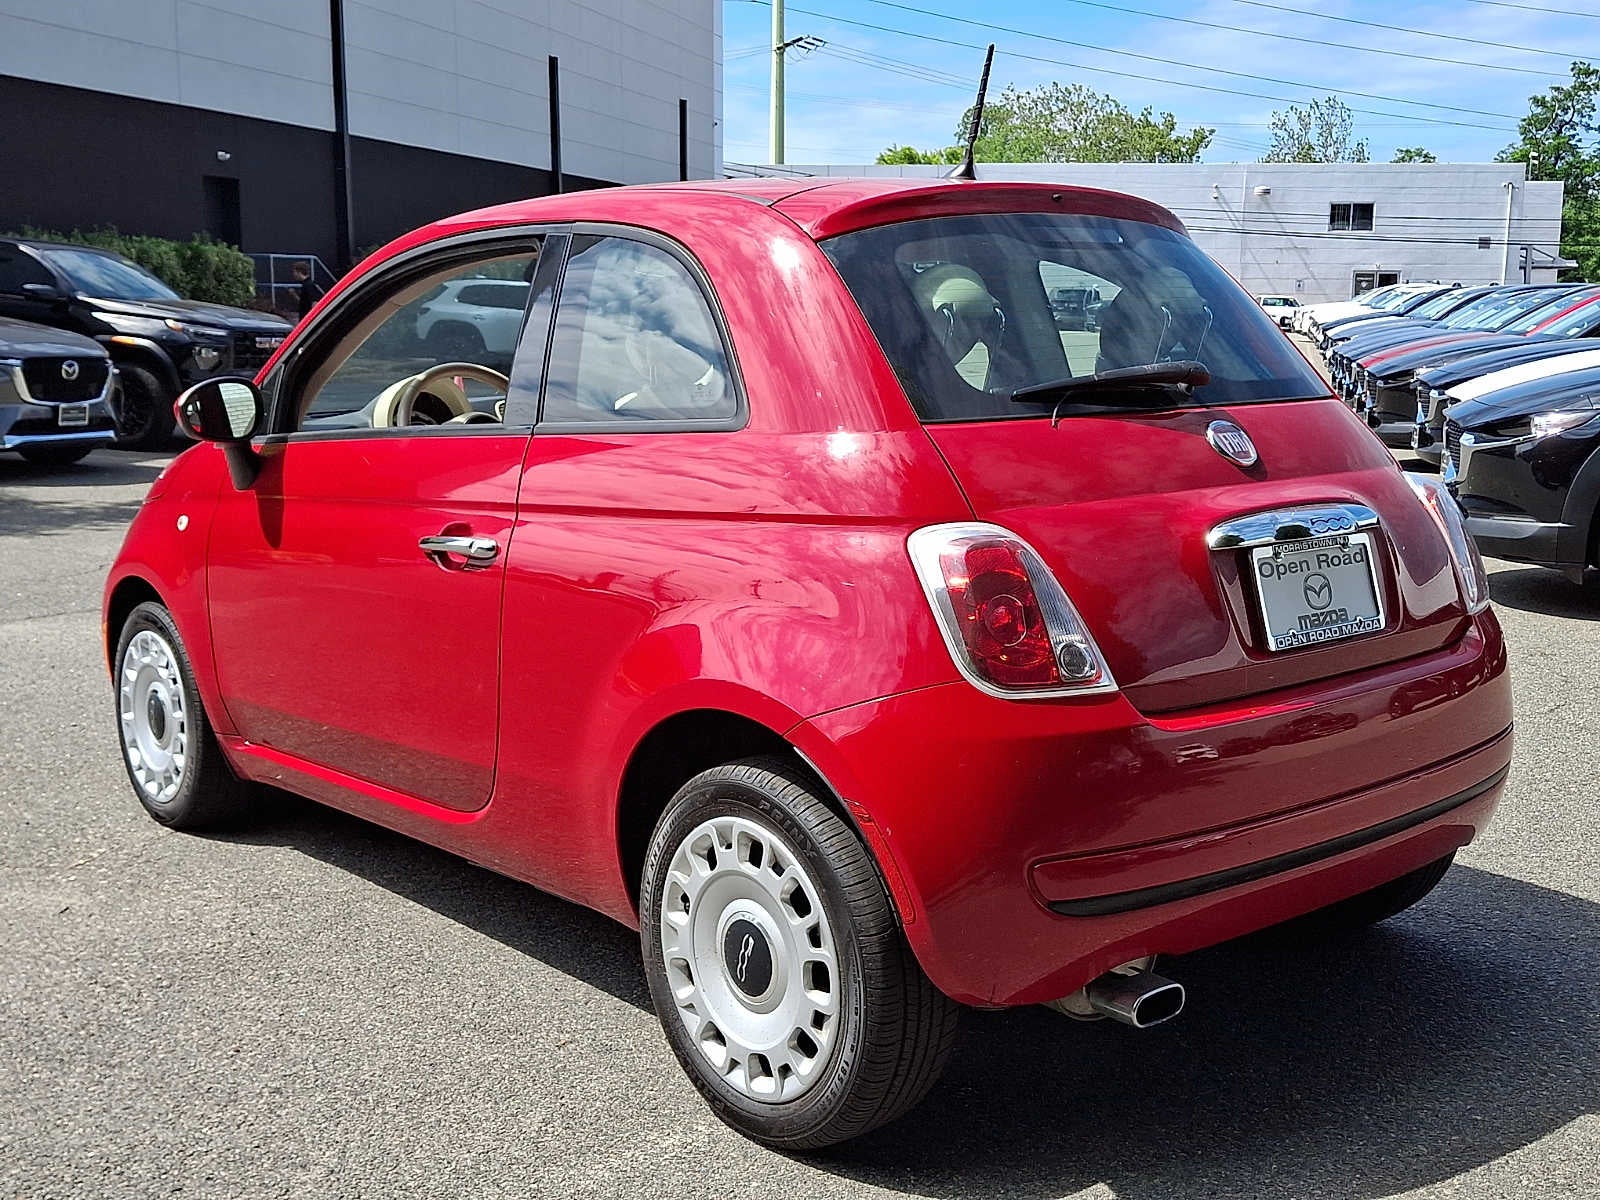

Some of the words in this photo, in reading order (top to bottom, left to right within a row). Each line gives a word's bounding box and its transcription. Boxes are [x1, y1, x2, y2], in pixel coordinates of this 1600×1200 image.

[1310, 516, 1352, 533] 500
[1258, 559, 1311, 581] Open
[1316, 548, 1365, 570] Road
[1276, 634, 1308, 648] OPEN
[1309, 628, 1340, 642] ROAD
[1341, 619, 1381, 636] MAZDA
